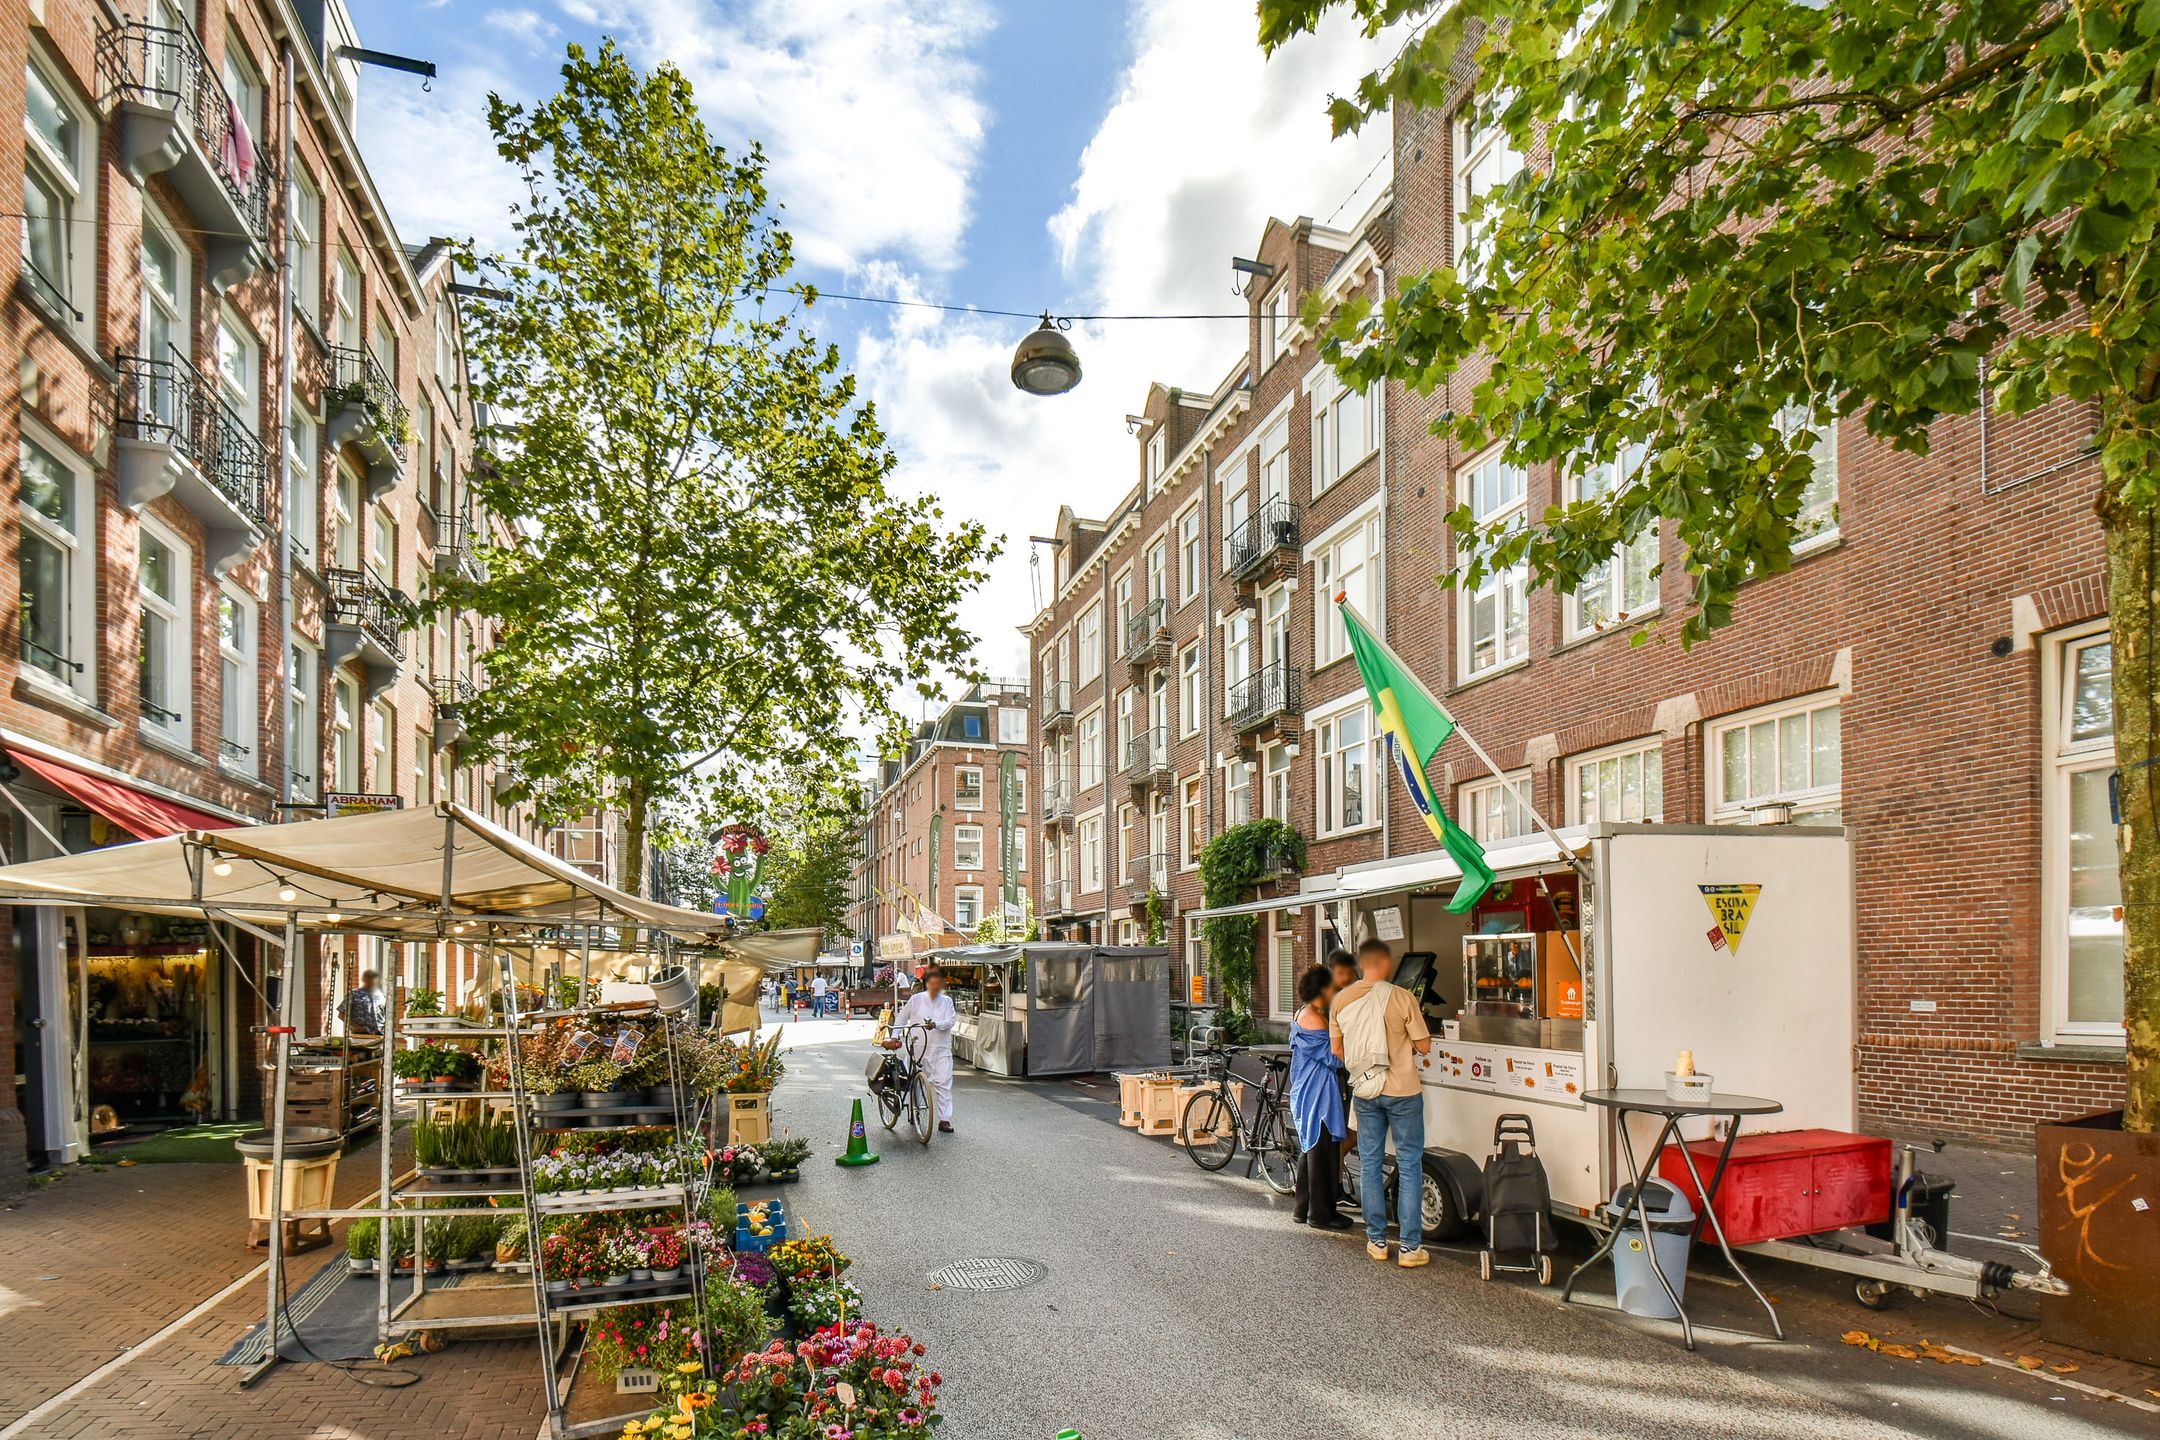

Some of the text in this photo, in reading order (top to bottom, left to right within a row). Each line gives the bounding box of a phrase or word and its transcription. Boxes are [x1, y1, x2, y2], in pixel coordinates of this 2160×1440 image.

[331, 796, 396, 805] ABRAHAM
[1005, 828, 1013, 888] Hummus
[1721, 909, 1744, 921] BRA
